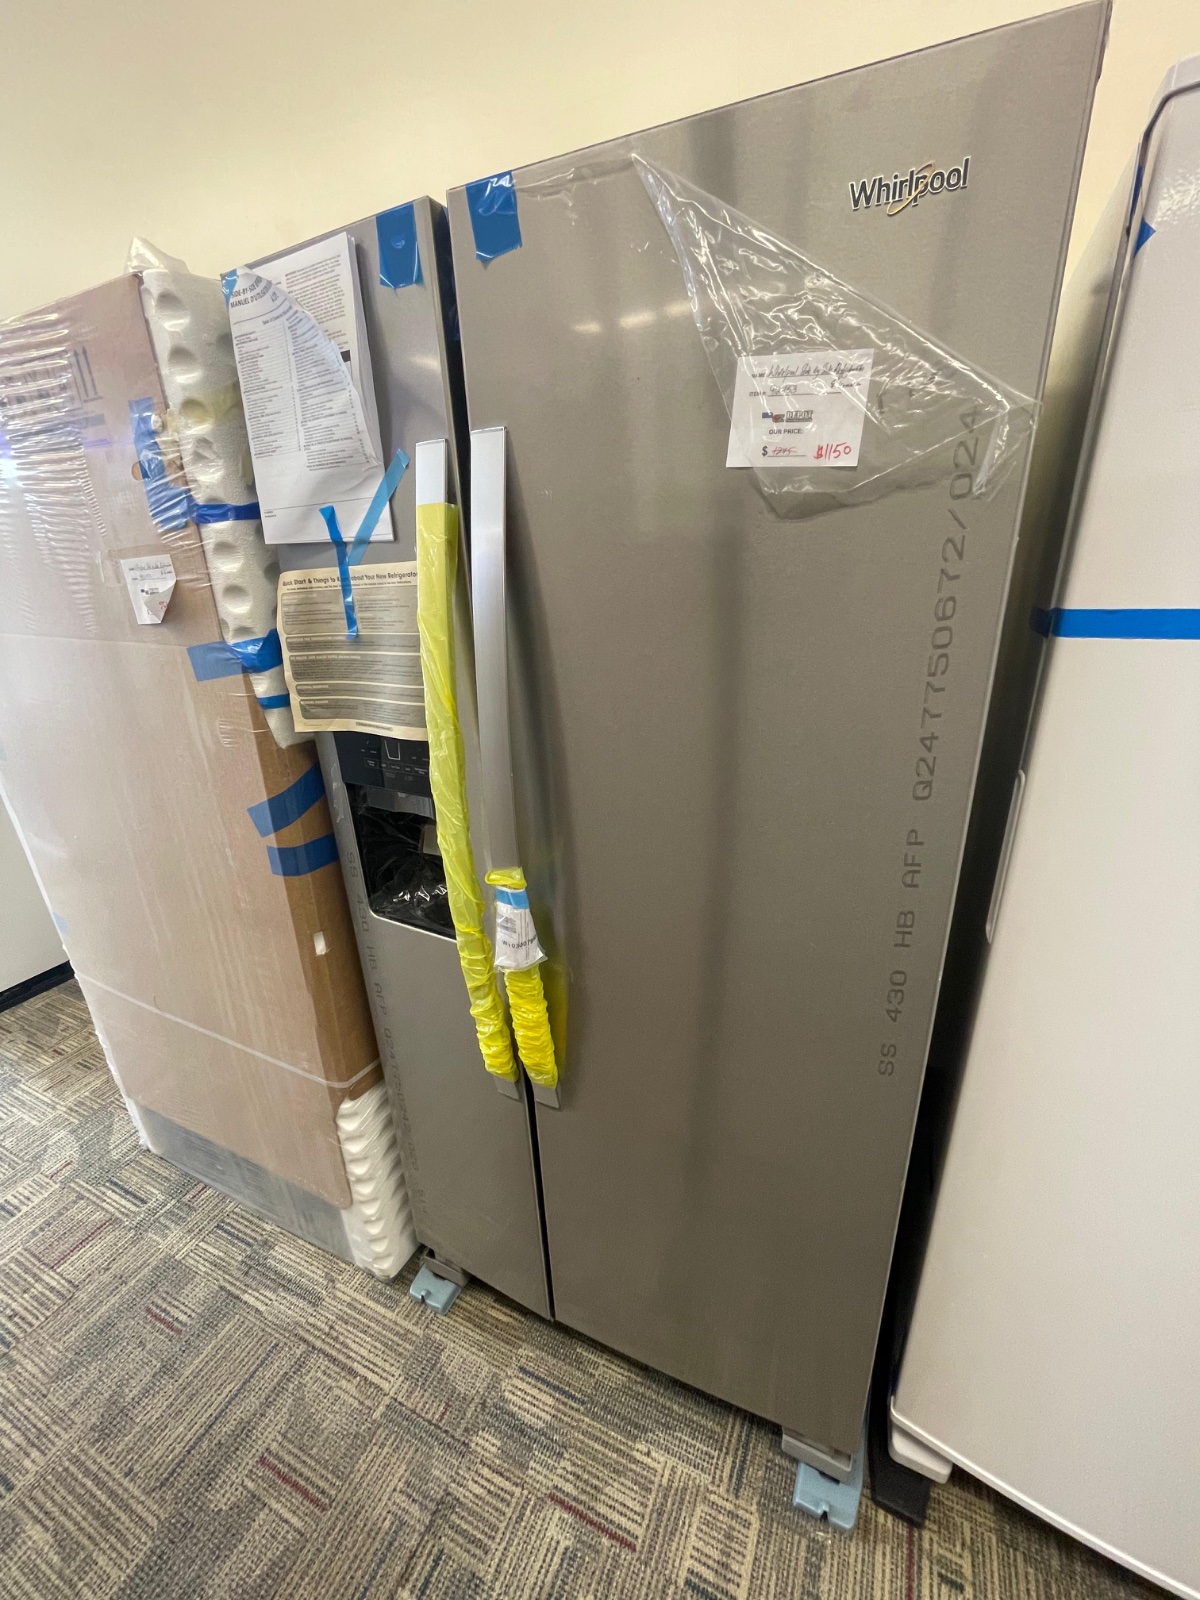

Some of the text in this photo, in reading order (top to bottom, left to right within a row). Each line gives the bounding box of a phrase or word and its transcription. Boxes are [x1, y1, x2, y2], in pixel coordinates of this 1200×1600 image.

[849, 155, 971, 211] Whirlpool
[762, 445, 768, 457] $
[901, 828, 925, 889] AFP
[347, 852, 359, 878] SS
[357, 893, 370, 932] 430
[366, 946, 378, 970] HB
[893, 910, 916, 948] HB
[885, 969, 908, 1023] 430
[878, 1042, 897, 1077] SS
